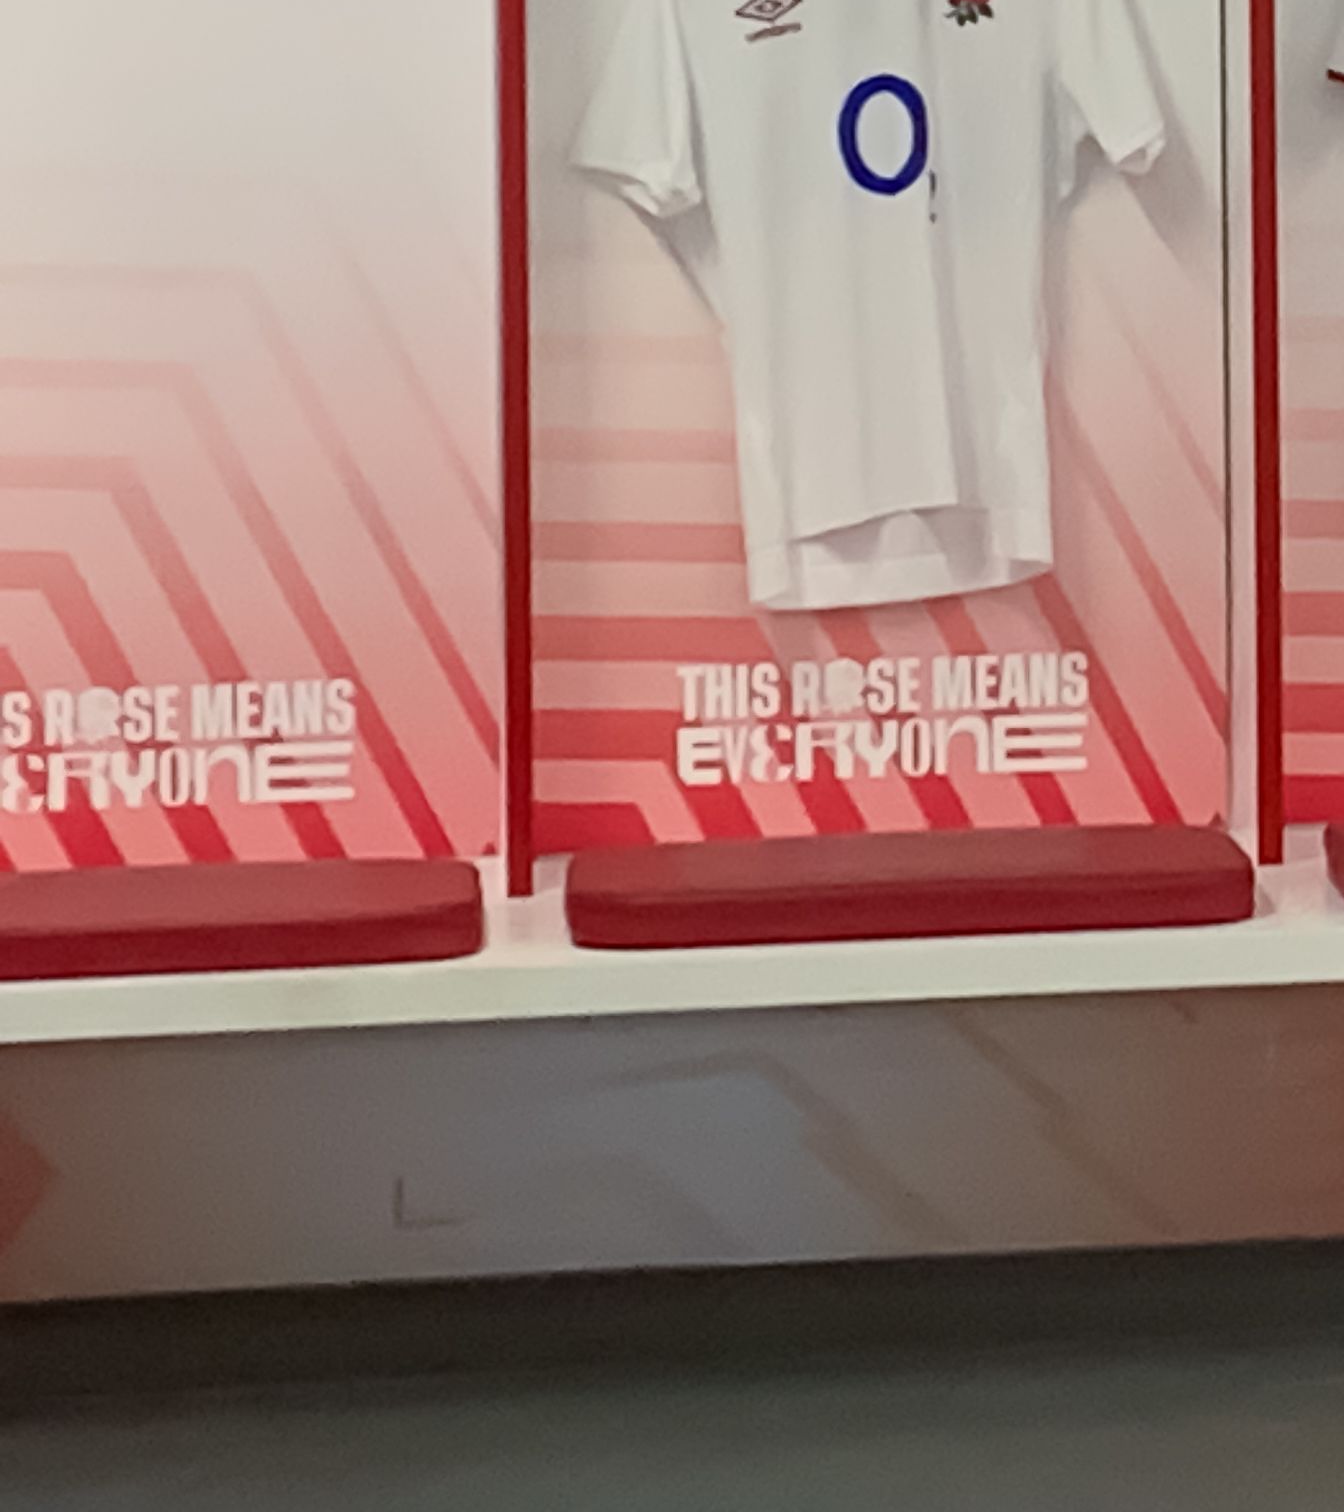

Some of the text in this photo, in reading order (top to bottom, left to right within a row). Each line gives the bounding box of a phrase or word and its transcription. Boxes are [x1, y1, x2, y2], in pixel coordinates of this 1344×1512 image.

[190, 678, 356, 740] MEANS
[676, 662, 781, 720] THIS
[932, 651, 1088, 709] MEANS
